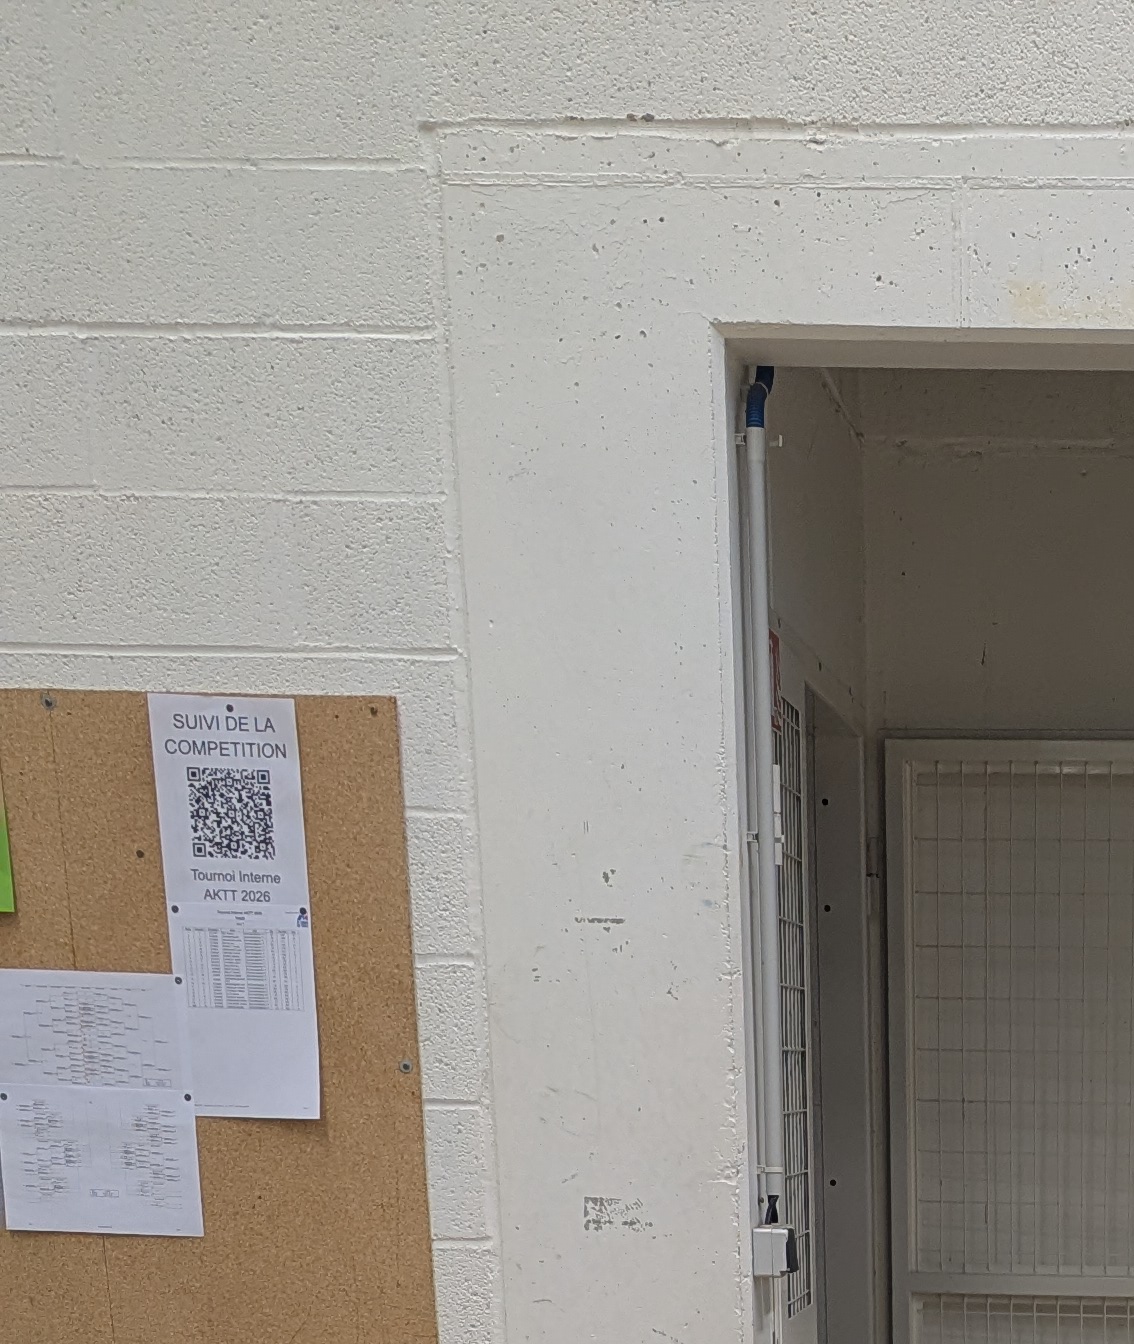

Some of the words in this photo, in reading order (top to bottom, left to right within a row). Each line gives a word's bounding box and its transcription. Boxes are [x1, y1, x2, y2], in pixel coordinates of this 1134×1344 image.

[172, 713, 220, 731] SUIVI
[225, 715, 250, 732] DE
[254, 716, 276, 733] LA
[164, 738, 287, 759] COMPETITION
[190, 868, 236, 882] Tournoi
[239, 870, 281, 884] Interne
[203, 888, 238, 902] AKTT
[241, 889, 271, 903] 2026
